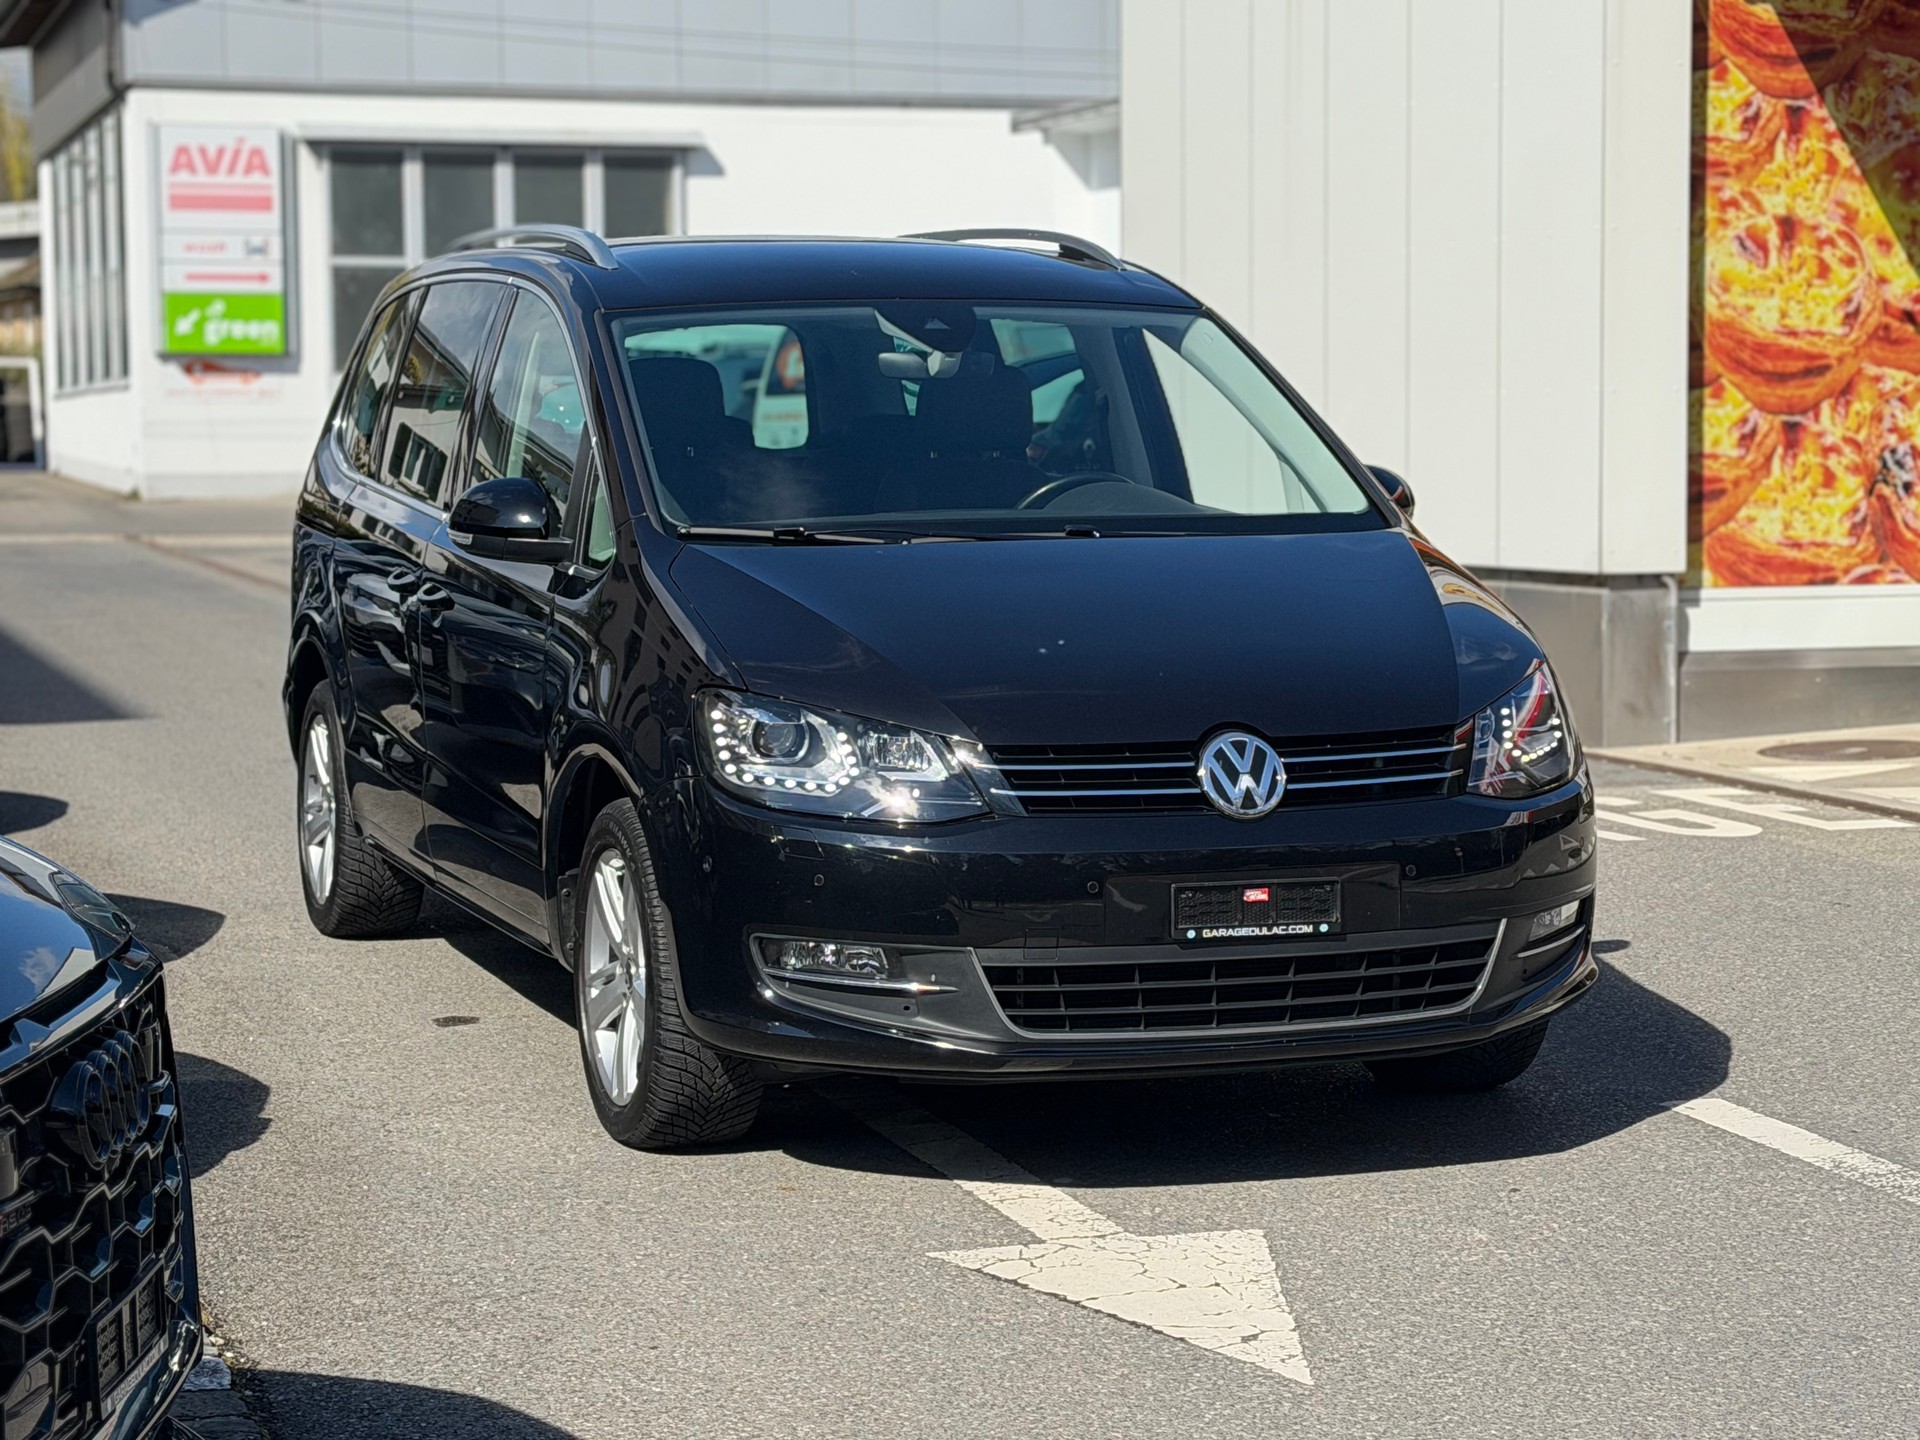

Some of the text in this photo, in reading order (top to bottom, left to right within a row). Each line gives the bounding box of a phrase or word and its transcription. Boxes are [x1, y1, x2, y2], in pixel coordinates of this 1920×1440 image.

[204, 318, 279, 346] green
[1202, 732, 1285, 818] VW
[1203, 924, 1313, 938] GARAGEDULAC.COM
